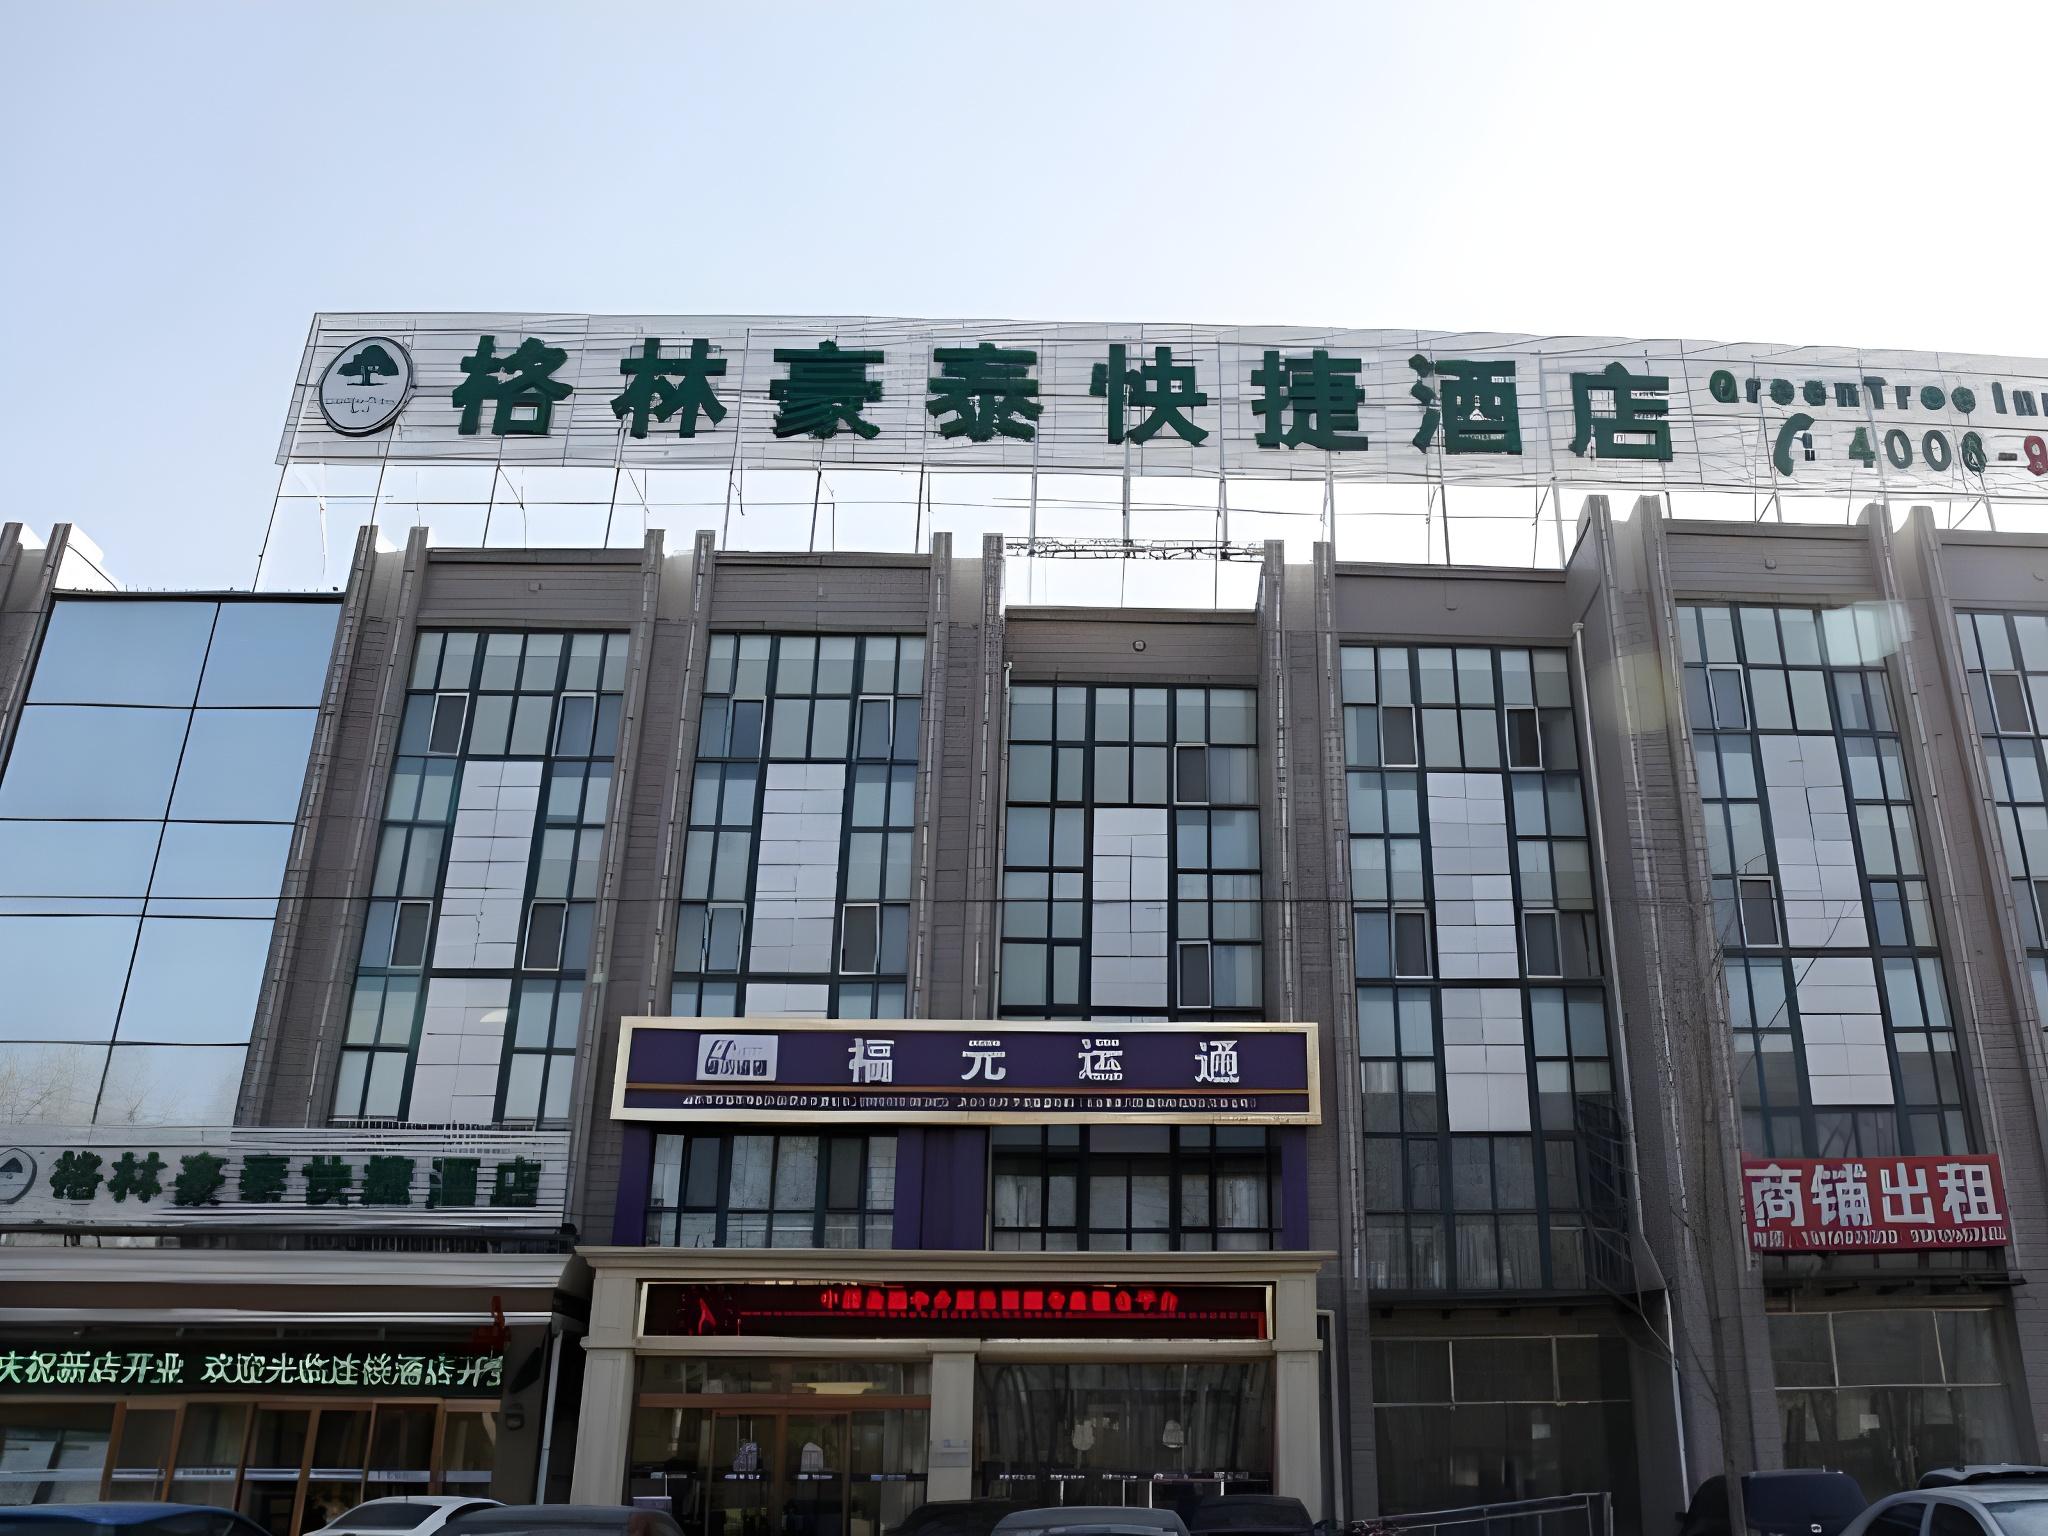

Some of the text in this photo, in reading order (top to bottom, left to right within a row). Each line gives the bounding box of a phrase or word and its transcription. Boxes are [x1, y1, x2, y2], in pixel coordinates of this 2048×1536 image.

[452, 333, 1673, 462] 格林豪泰快捷酒店
[847, 1037, 1240, 1084] 福元运通
[1745, 1162, 2003, 1227] 商铺出租
